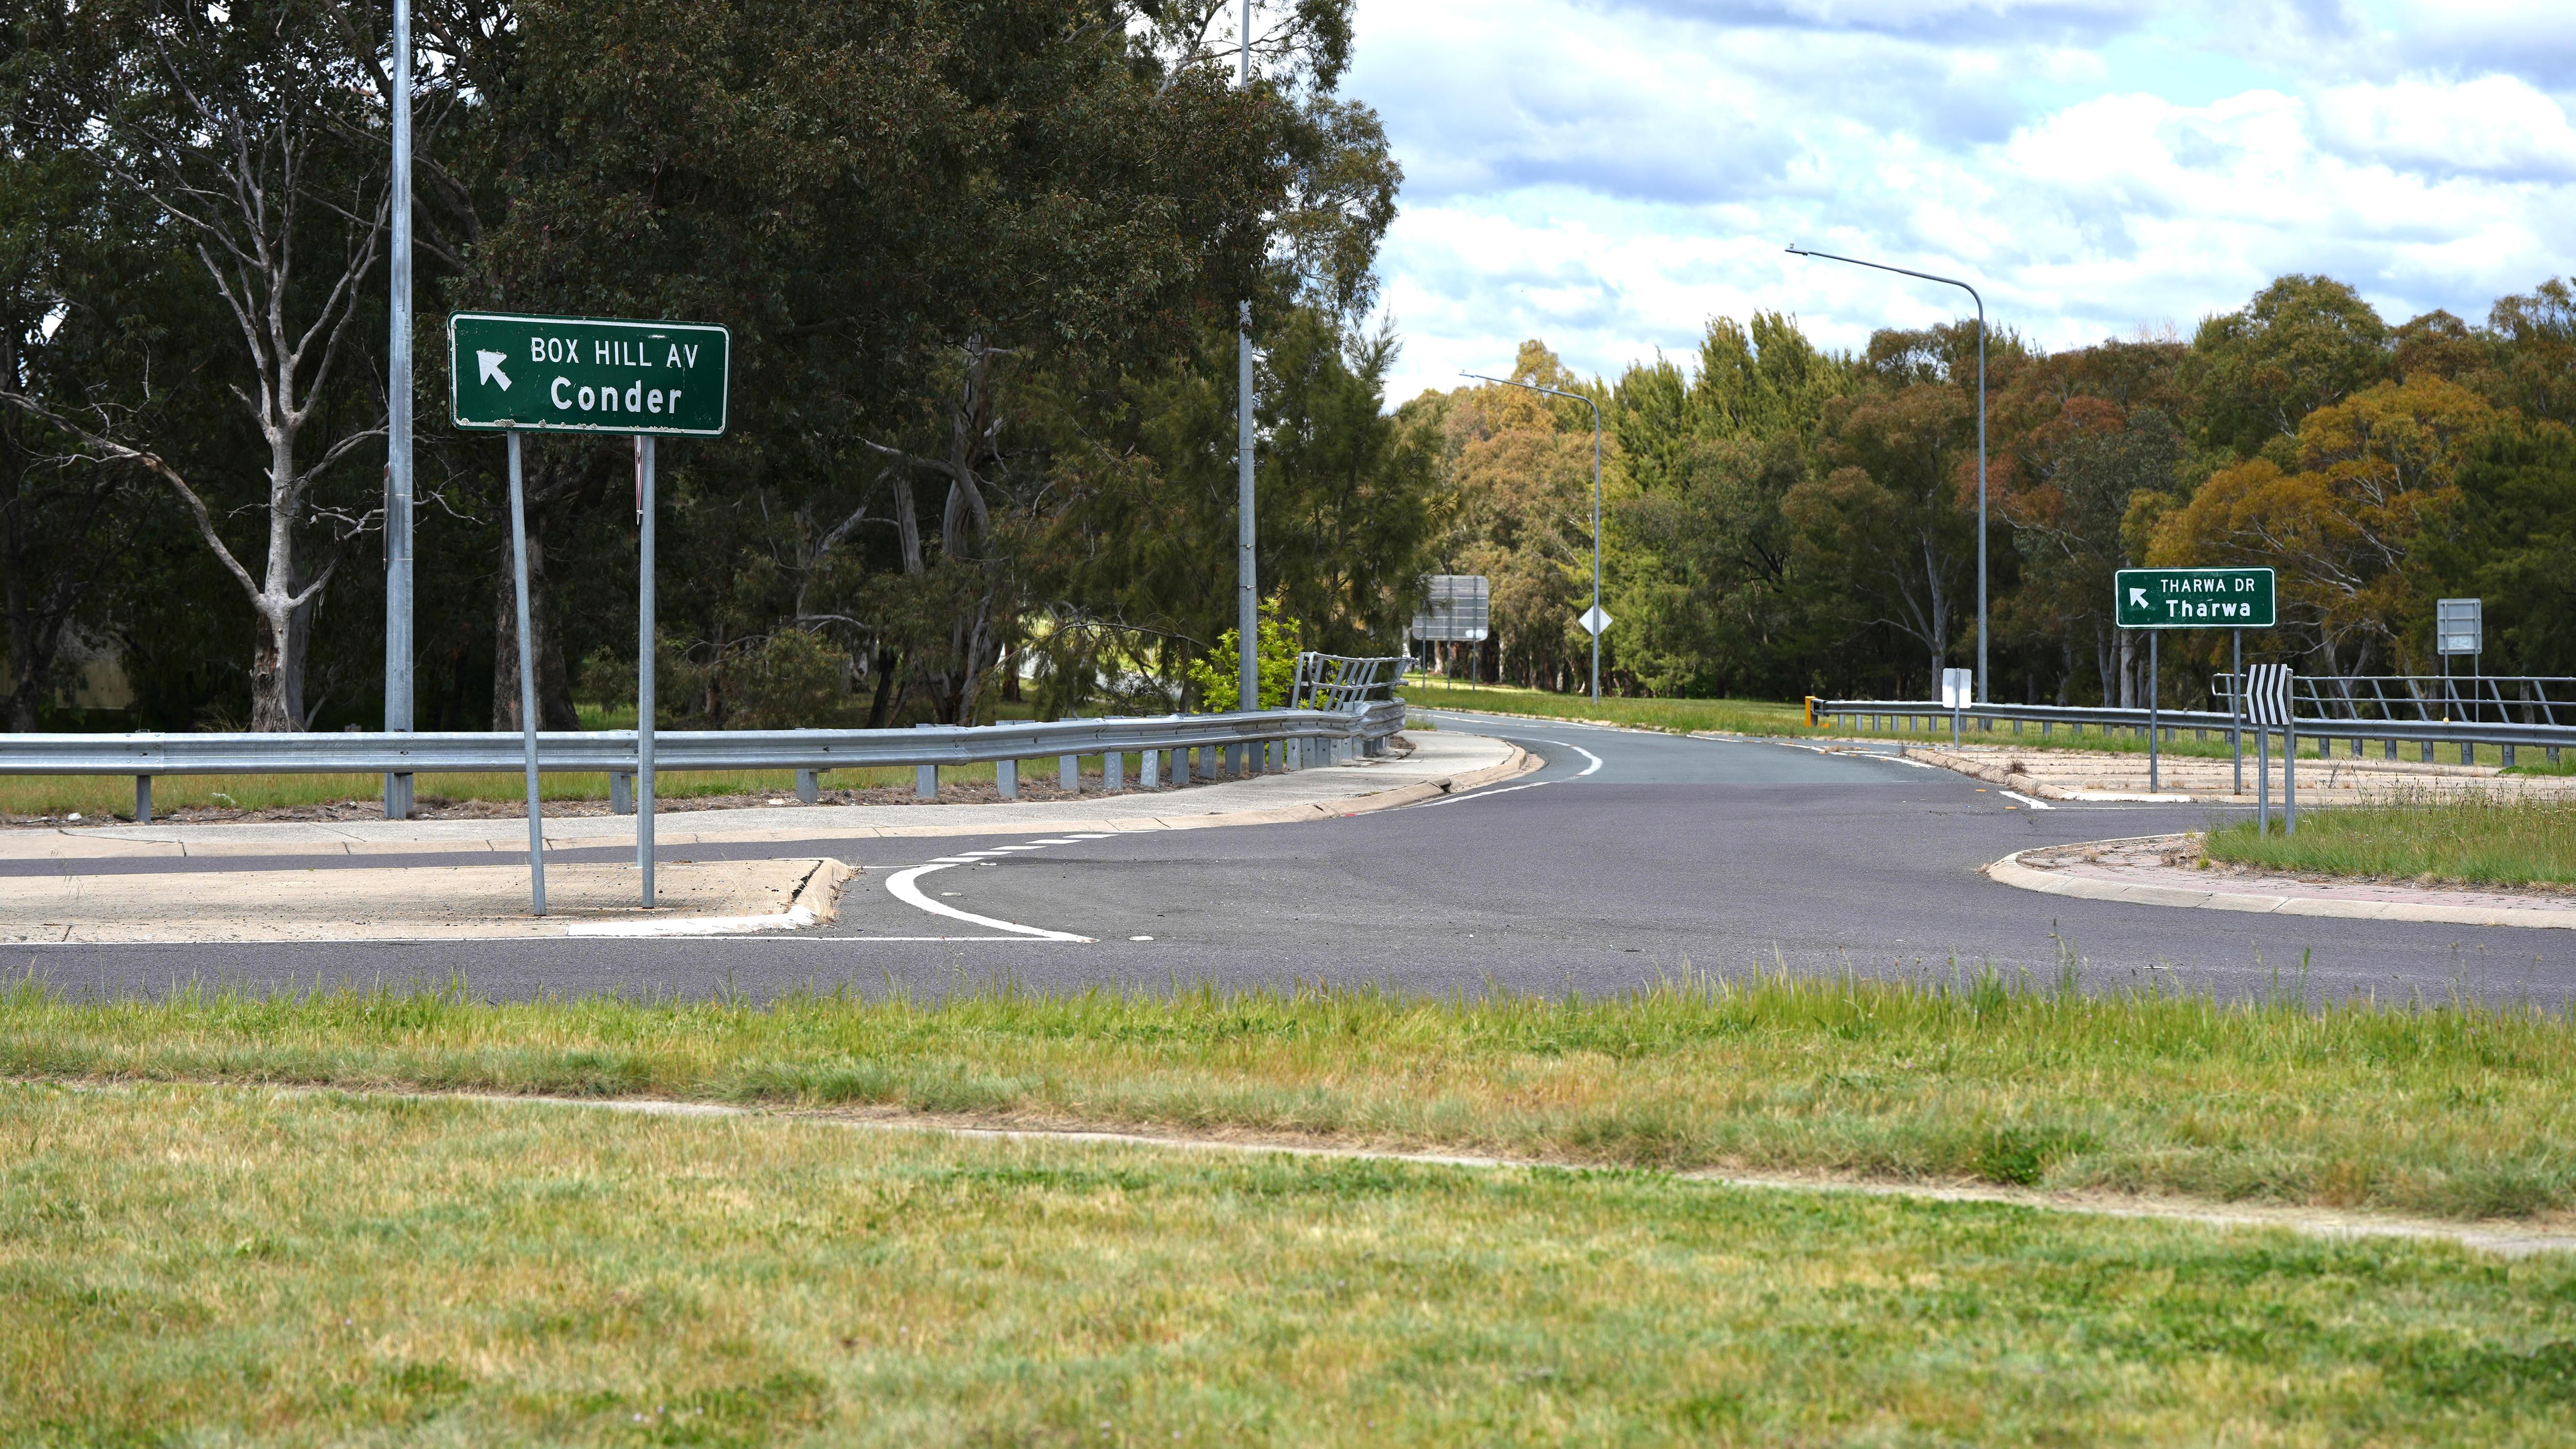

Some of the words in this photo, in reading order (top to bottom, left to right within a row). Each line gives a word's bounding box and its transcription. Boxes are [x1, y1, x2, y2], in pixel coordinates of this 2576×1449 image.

[531, 337, 579, 363] BOX
[595, 340, 652, 366] HILL
[666, 344, 698, 368] AV
[551, 376, 682, 414] Conder
[2160, 578, 2226, 592] THARWA
[2235, 578, 2255, 592] DR
[2165, 599, 2251, 617] Tharwa
